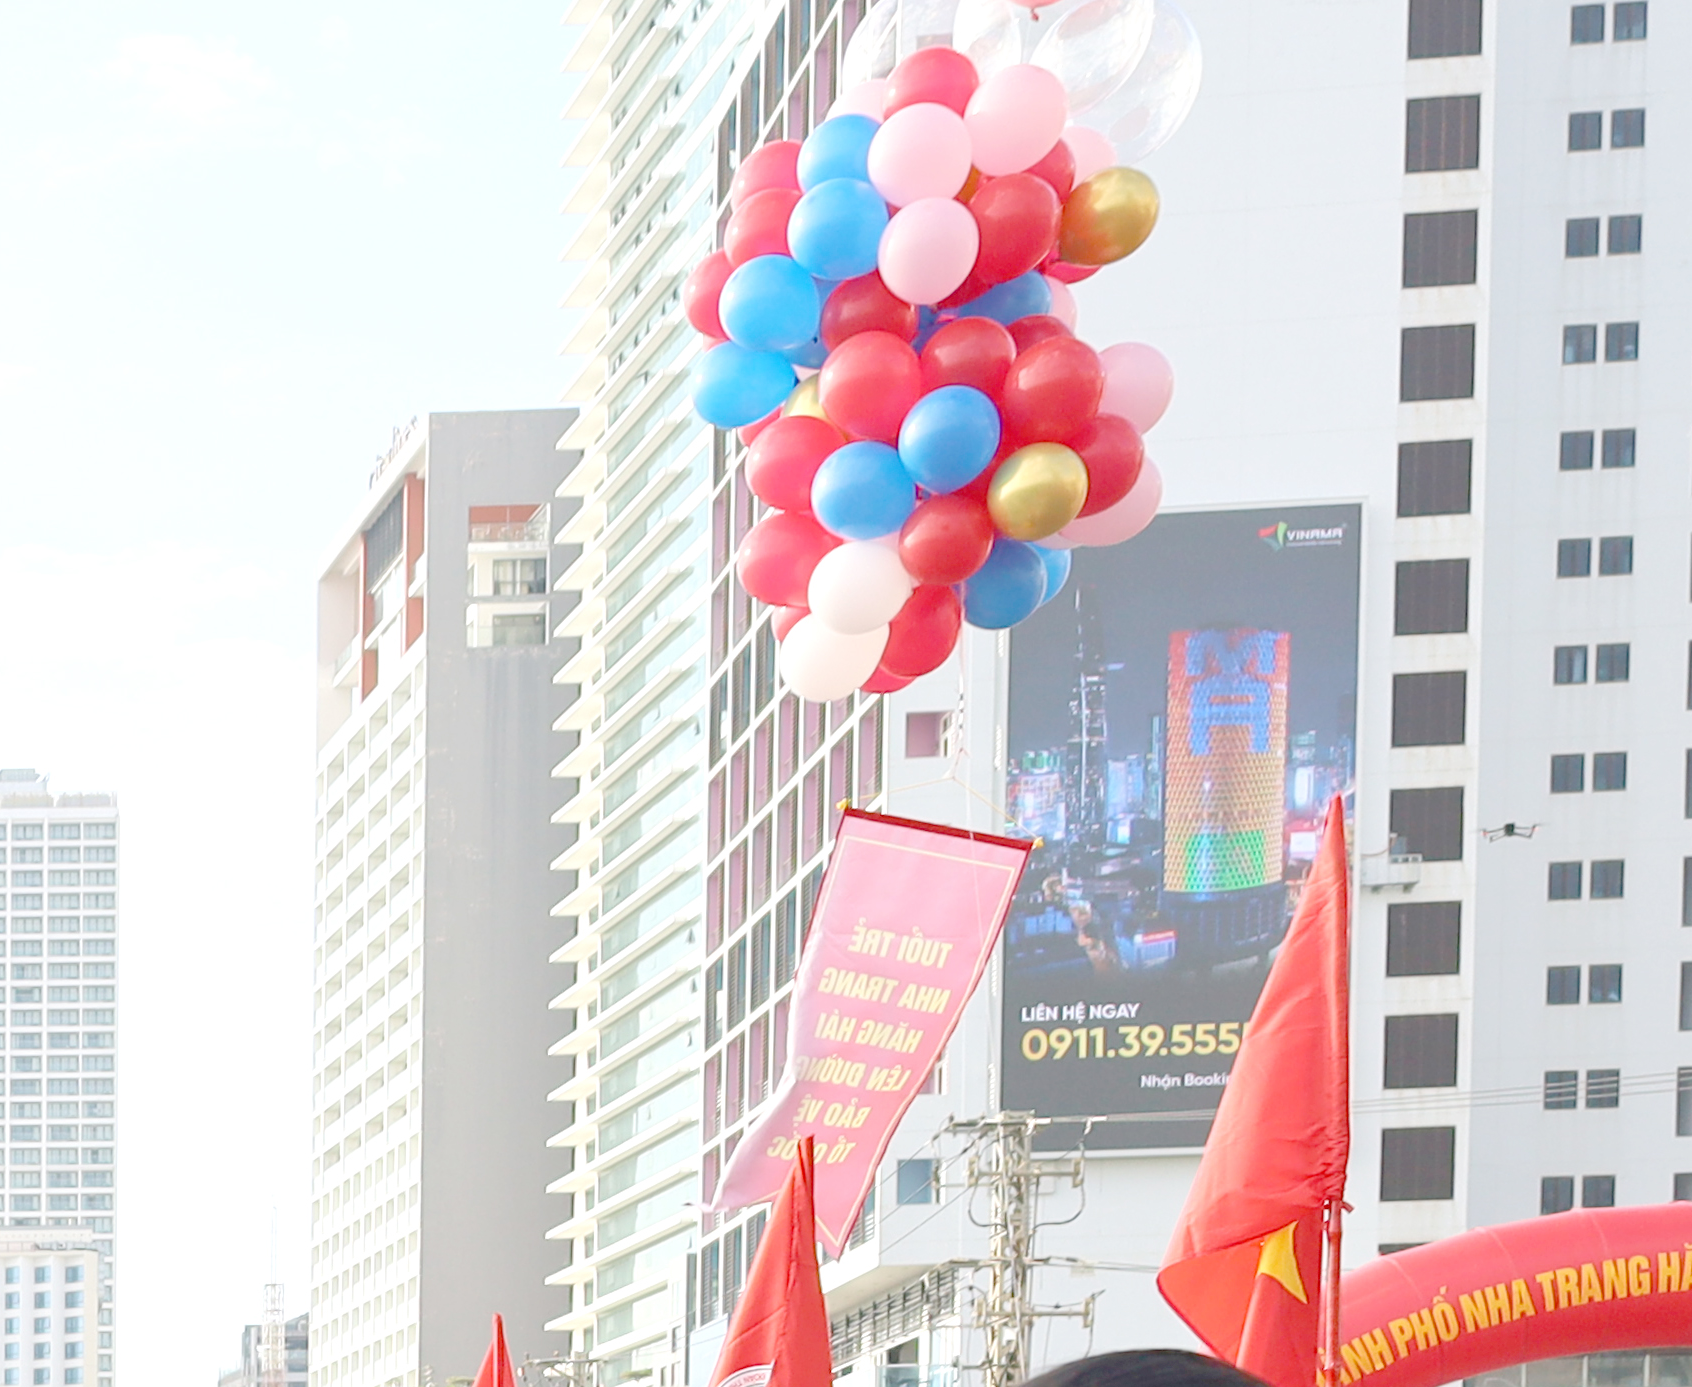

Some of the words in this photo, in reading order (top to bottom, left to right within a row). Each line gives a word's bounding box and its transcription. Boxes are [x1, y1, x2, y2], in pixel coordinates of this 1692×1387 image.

[1021, 1002, 1058, 1022] LIÊN
[1062, 1001, 1085, 1024] HỆ
[1089, 1002, 1141, 1020] NGAY
[1140, 1074, 1181, 1090] Nhận
[1389, 1285, 1460, 1359] PHỐ
[1458, 1278, 1537, 1333] NHA
[1535, 1255, 1651, 1313] TRANG
